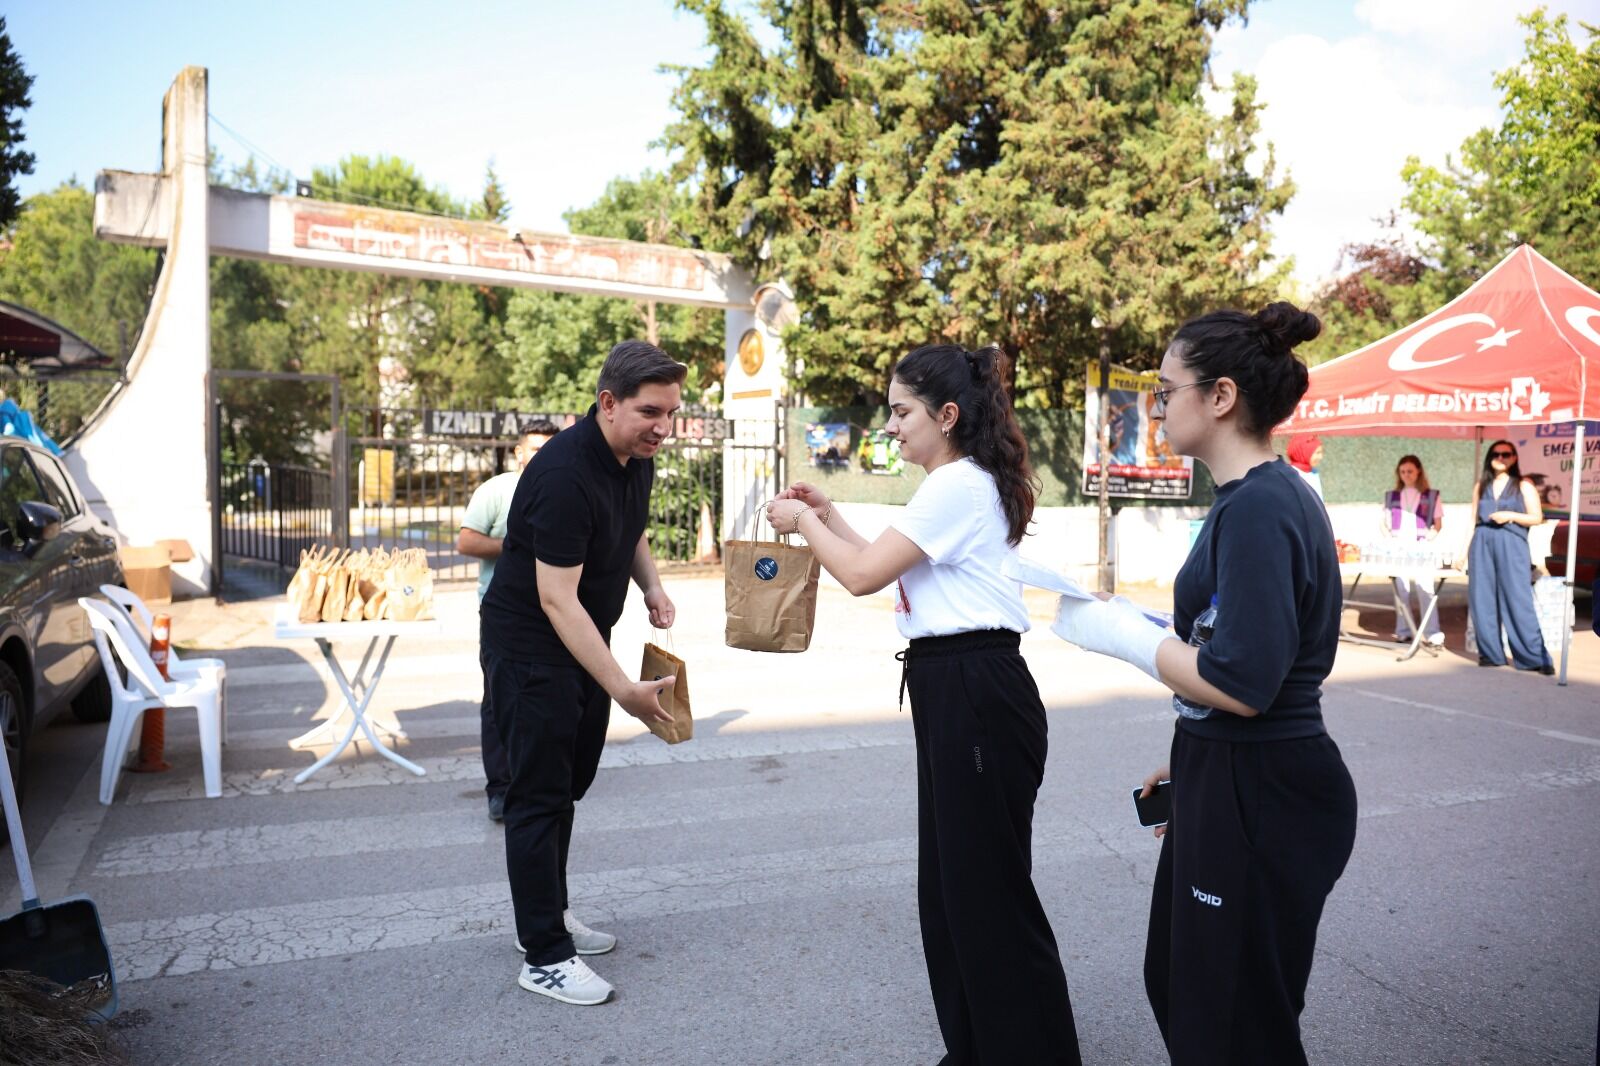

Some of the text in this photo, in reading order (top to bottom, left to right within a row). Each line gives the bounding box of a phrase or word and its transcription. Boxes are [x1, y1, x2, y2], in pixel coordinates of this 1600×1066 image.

[1299, 387, 1509, 419] T.C. İZMİT BELEDİYESİ
[432, 411, 496, 434] İZMİT
[1191, 886, 1222, 906] VOID
